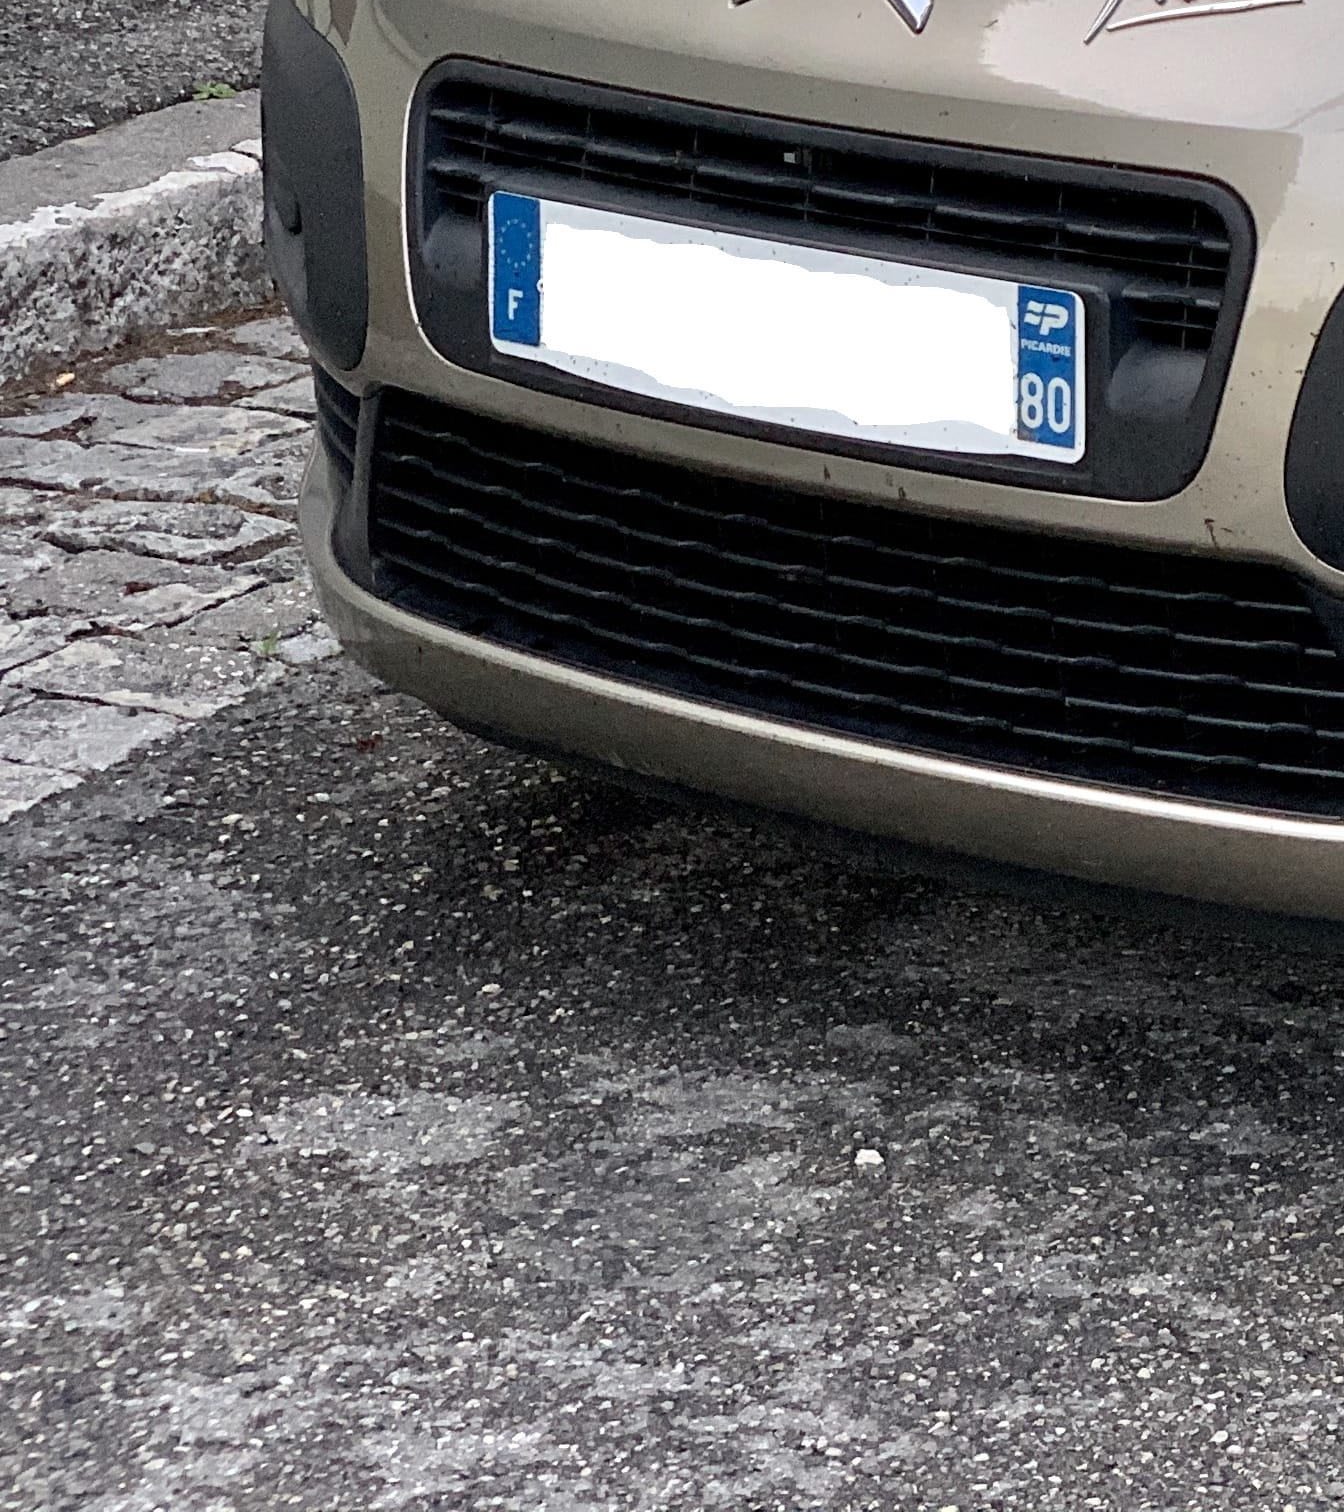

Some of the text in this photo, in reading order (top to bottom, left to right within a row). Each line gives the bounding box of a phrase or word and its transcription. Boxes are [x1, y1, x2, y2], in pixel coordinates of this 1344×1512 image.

[508, 288, 524, 320] F
[1021, 338, 1071, 357] PICARDIE
[1020, 372, 1072, 434] 80
